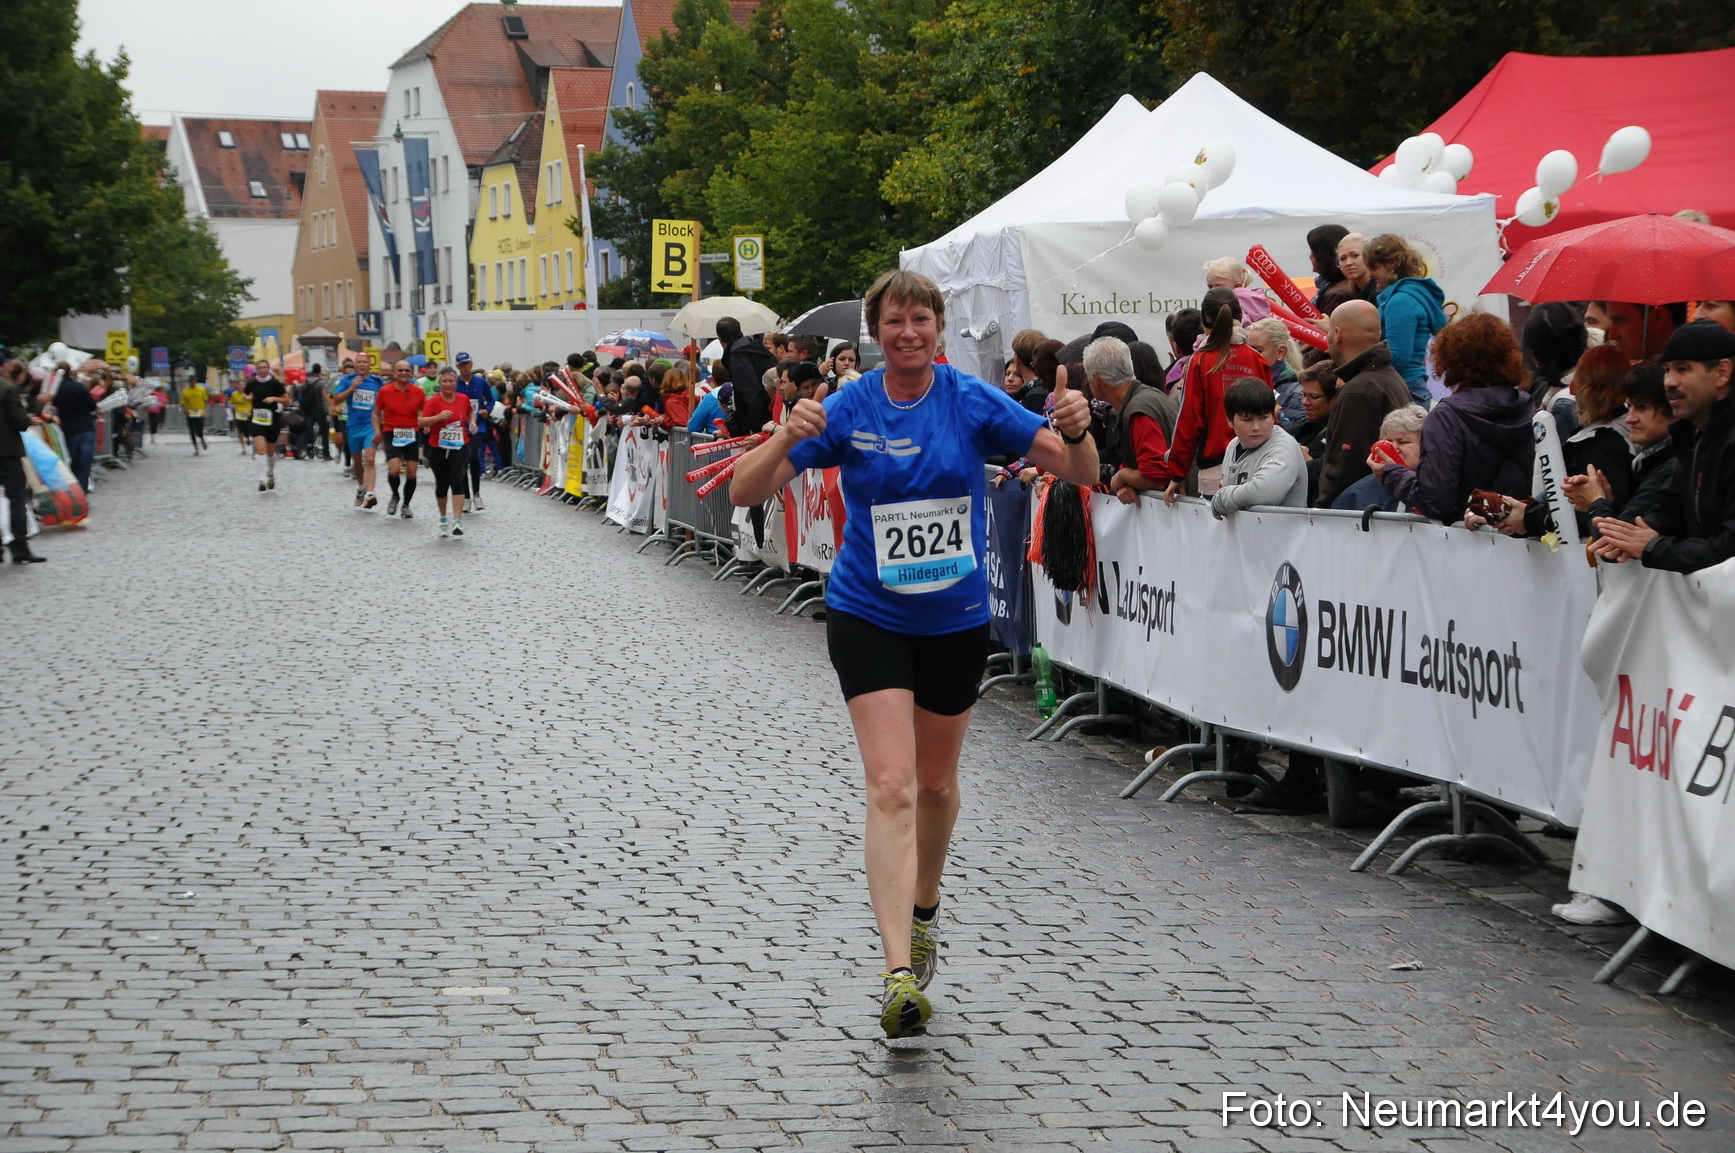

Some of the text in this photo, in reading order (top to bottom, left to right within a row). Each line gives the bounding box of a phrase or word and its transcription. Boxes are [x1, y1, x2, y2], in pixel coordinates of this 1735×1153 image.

[658, 223, 694, 237] Block
[664, 242, 687, 276] B
[1061, 292, 1141, 316] Kinder
[1280, 279, 1302, 304] BKK
[1299, 301, 1323, 320] udi
[111, 340, 122, 355] C
[430, 340, 441, 355] C
[441, 431, 461, 441] 2271
[874, 507, 954, 523] PARTL Neumarkt
[886, 519, 963, 560] 2624
[898, 562, 958, 582] Hildegard
[1317, 599, 1524, 719] BMW Laufsport
[1610, 674, 1696, 781] Audi
